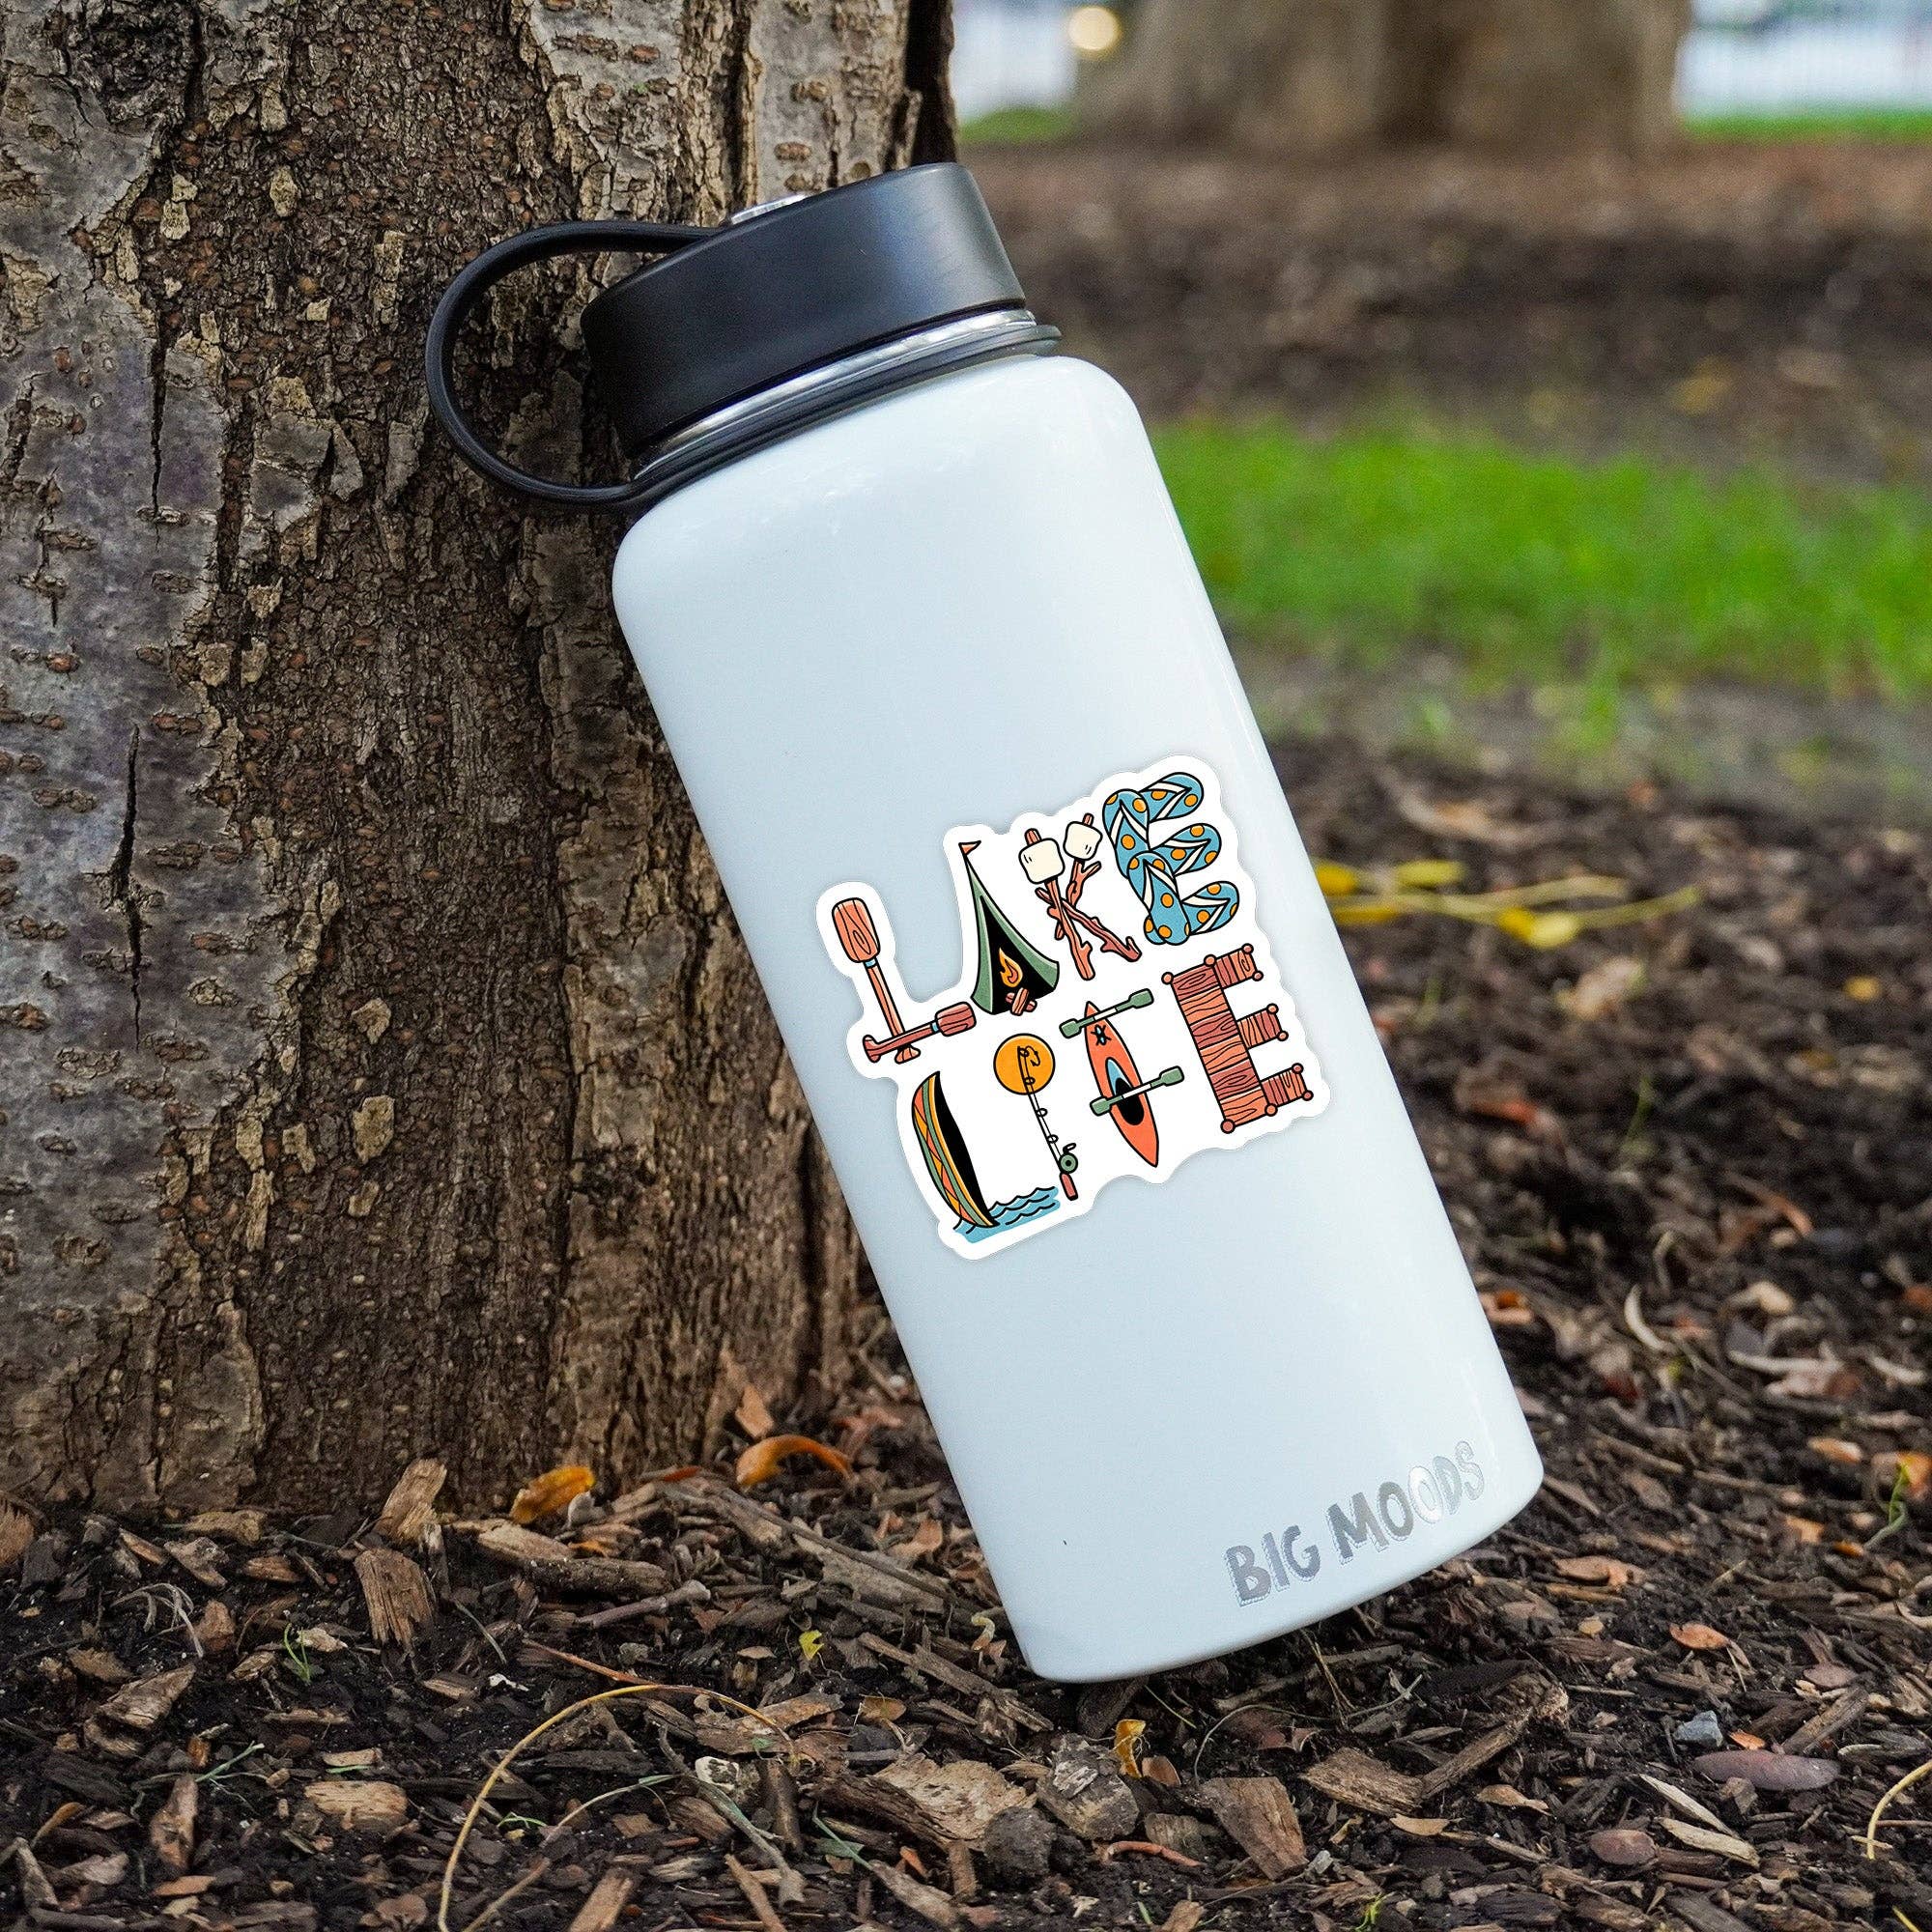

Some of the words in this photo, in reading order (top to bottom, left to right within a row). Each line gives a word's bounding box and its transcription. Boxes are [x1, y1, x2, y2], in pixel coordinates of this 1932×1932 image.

[832, 771, 1239, 1063] LAKE
[912, 944, 1313, 1243] LIFE
[1224, 1525, 1321, 1607] BIG
[1326, 1440, 1485, 1565] MOODS
